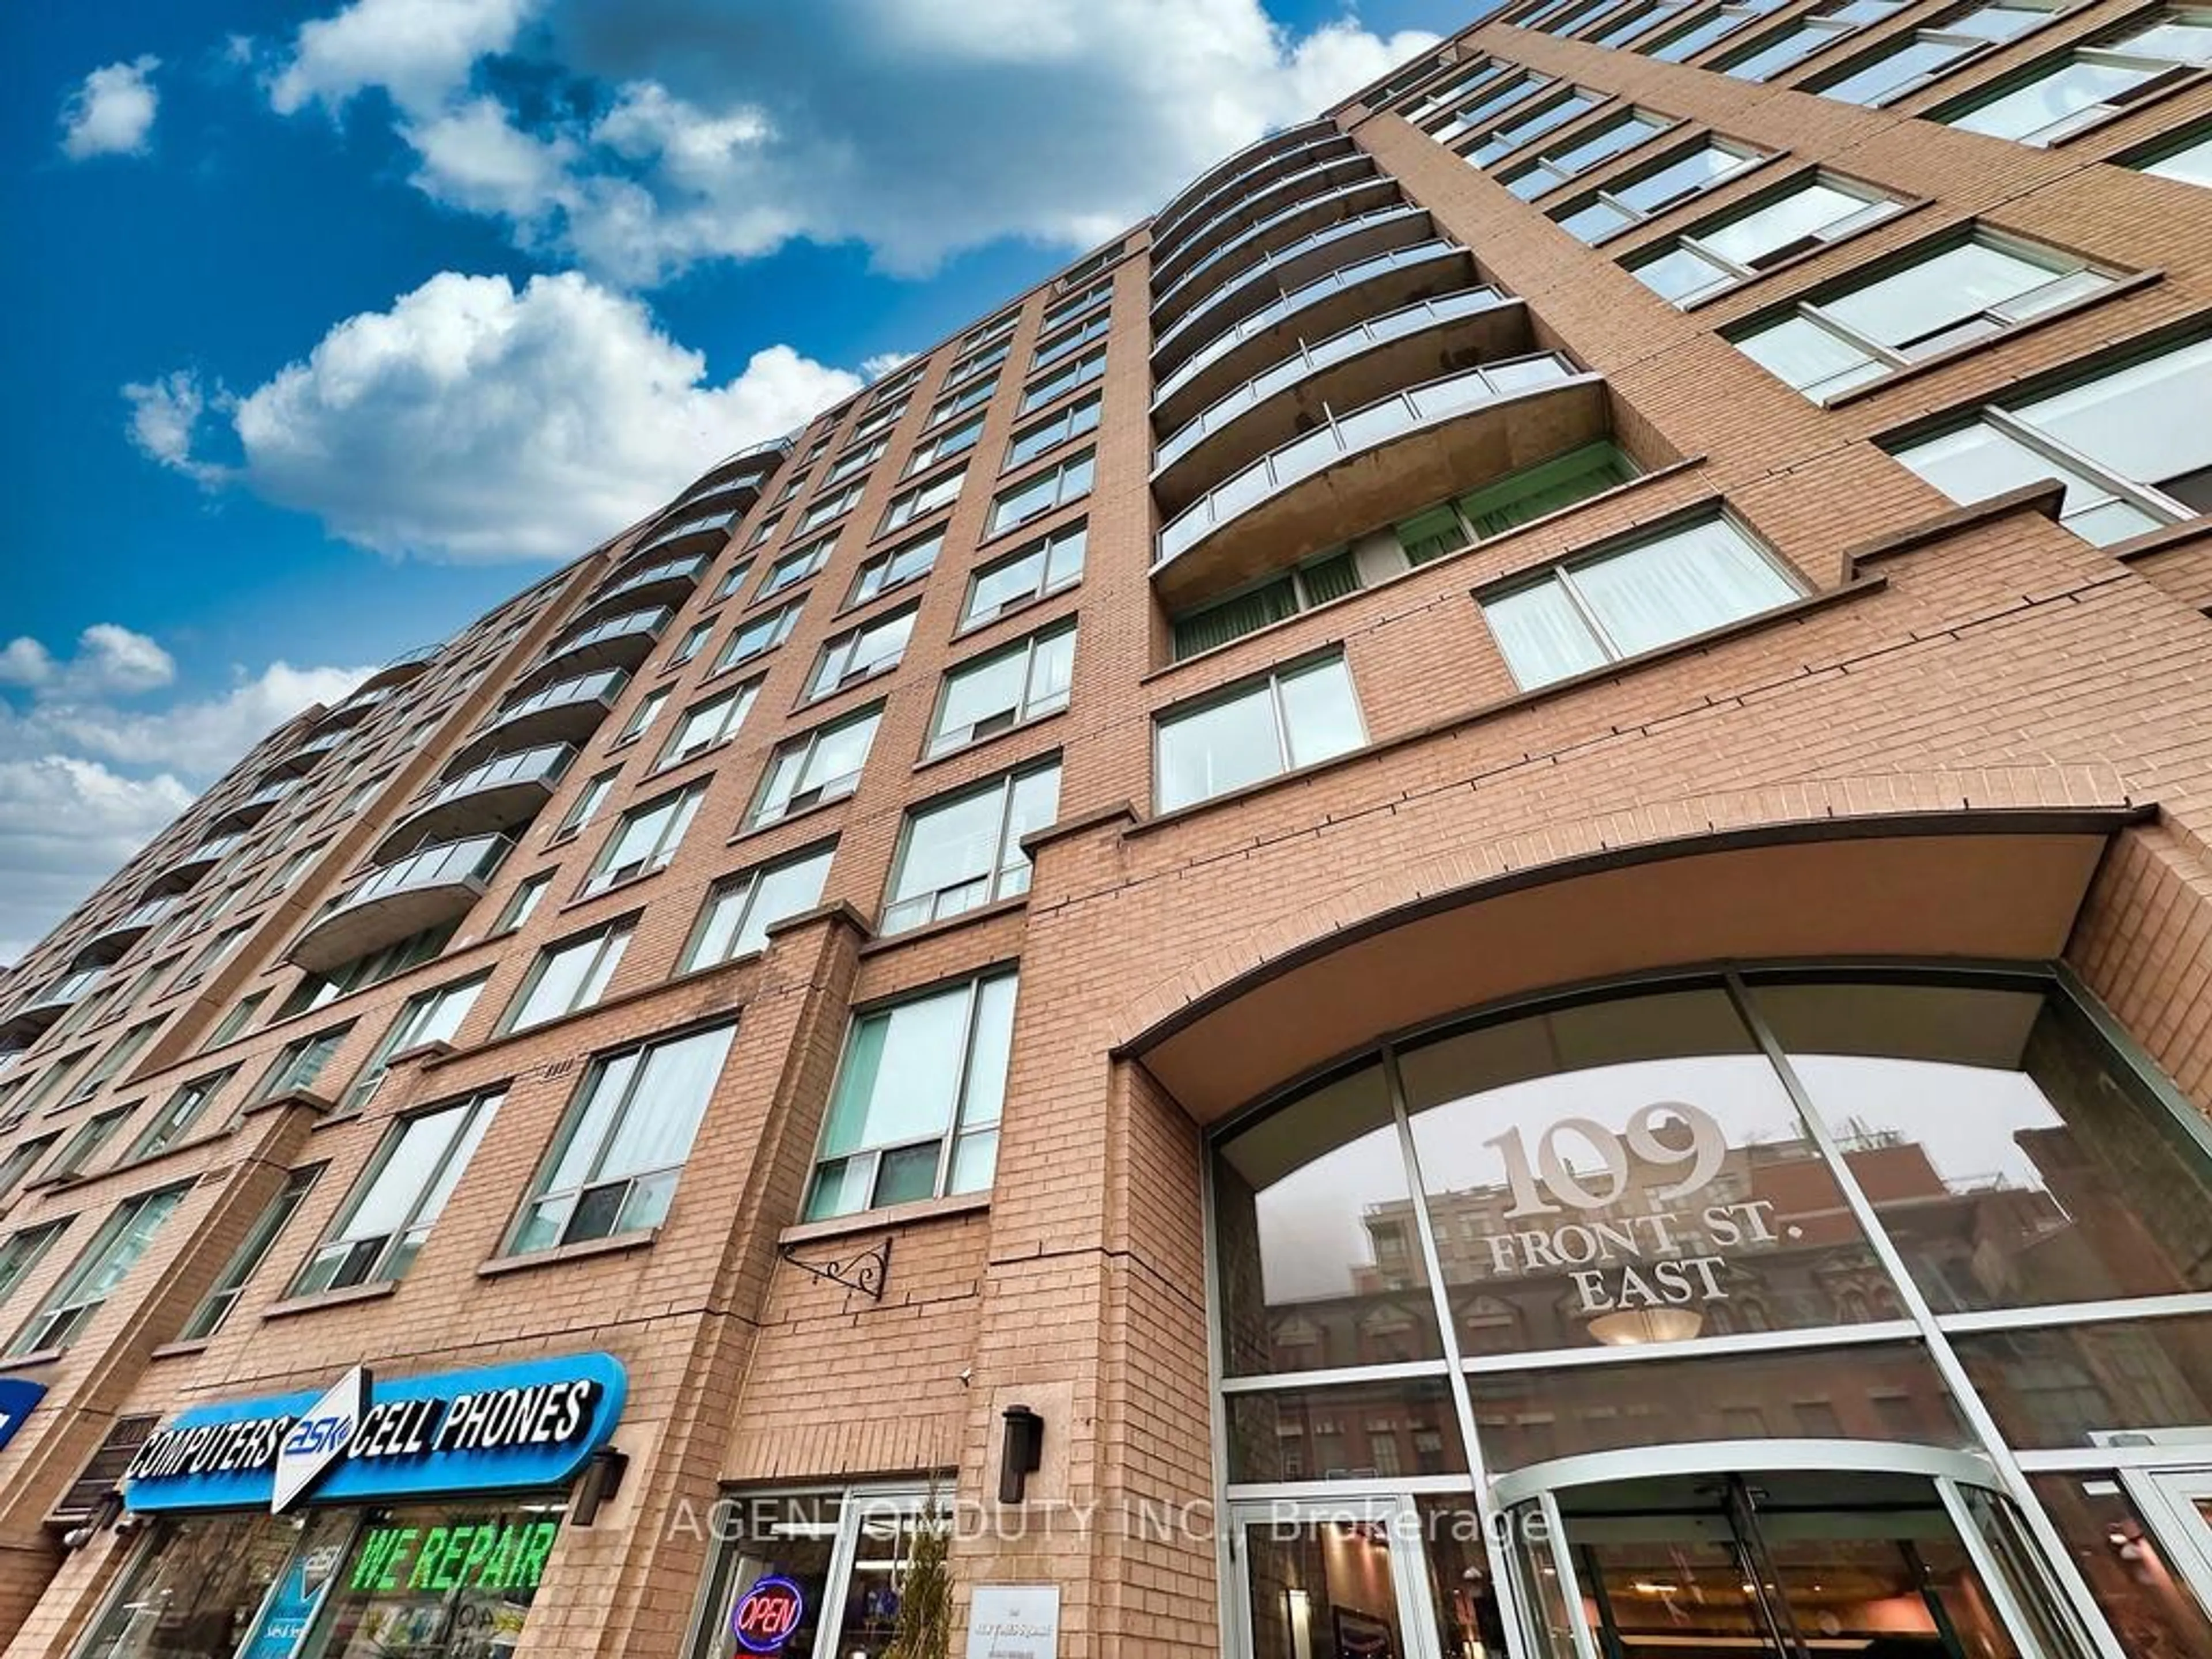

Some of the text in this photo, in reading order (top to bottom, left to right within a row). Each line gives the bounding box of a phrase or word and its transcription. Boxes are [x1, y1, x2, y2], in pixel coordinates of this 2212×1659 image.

[1482, 1101, 1728, 1219] 109
[1486, 1200, 1803, 1274] FRONT ST.
[1568, 1256, 1728, 1312] EAST
[125, 1416, 289, 1479] COMPUTERS
[348, 1398, 434, 1459] CELL
[433, 1379, 591, 1450] PHONES
[351, 1522, 556, 1589] WE REPAIR
[738, 1596, 798, 1633] OPEN
